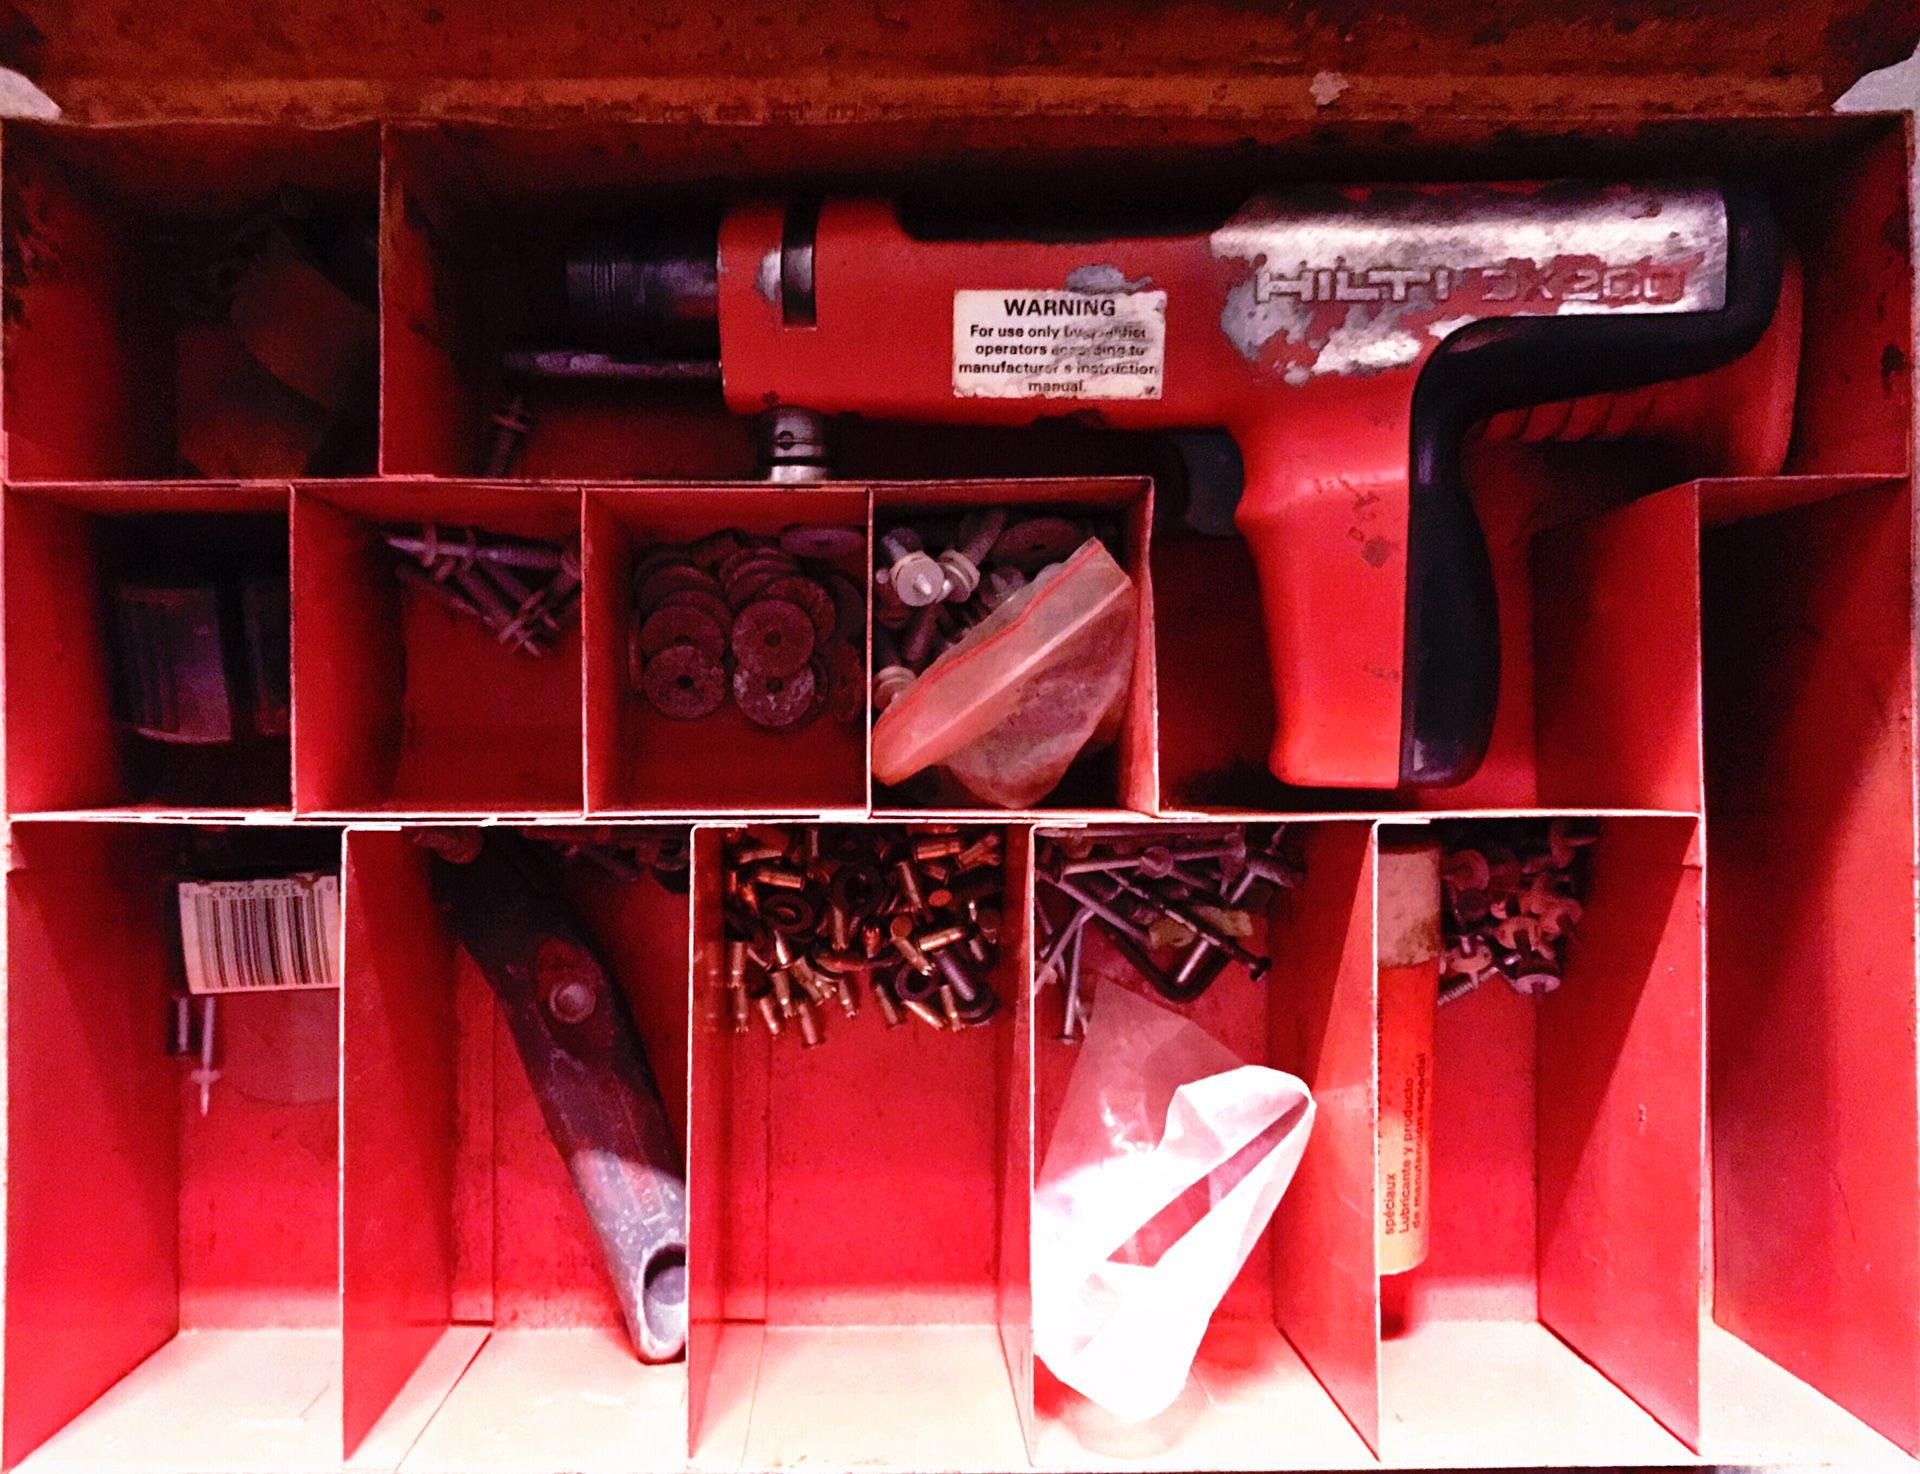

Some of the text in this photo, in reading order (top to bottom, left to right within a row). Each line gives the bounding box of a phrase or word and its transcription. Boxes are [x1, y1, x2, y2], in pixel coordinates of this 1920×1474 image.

[1255, 266, 1451, 303] HILTI
[1004, 298, 1116, 317] WARNING
[970, 324, 994, 338] For
[998, 326, 1024, 338] use
[1028, 325, 1060, 340] only
[975, 344, 1048, 358] operators
[958, 361, 1072, 375] manufacturers
[1399, 1077, 1414, 1233] Lubricante y producto
[1384, 1173, 1397, 1235] spéciaux
[1412, 1214, 1420, 1229] de
